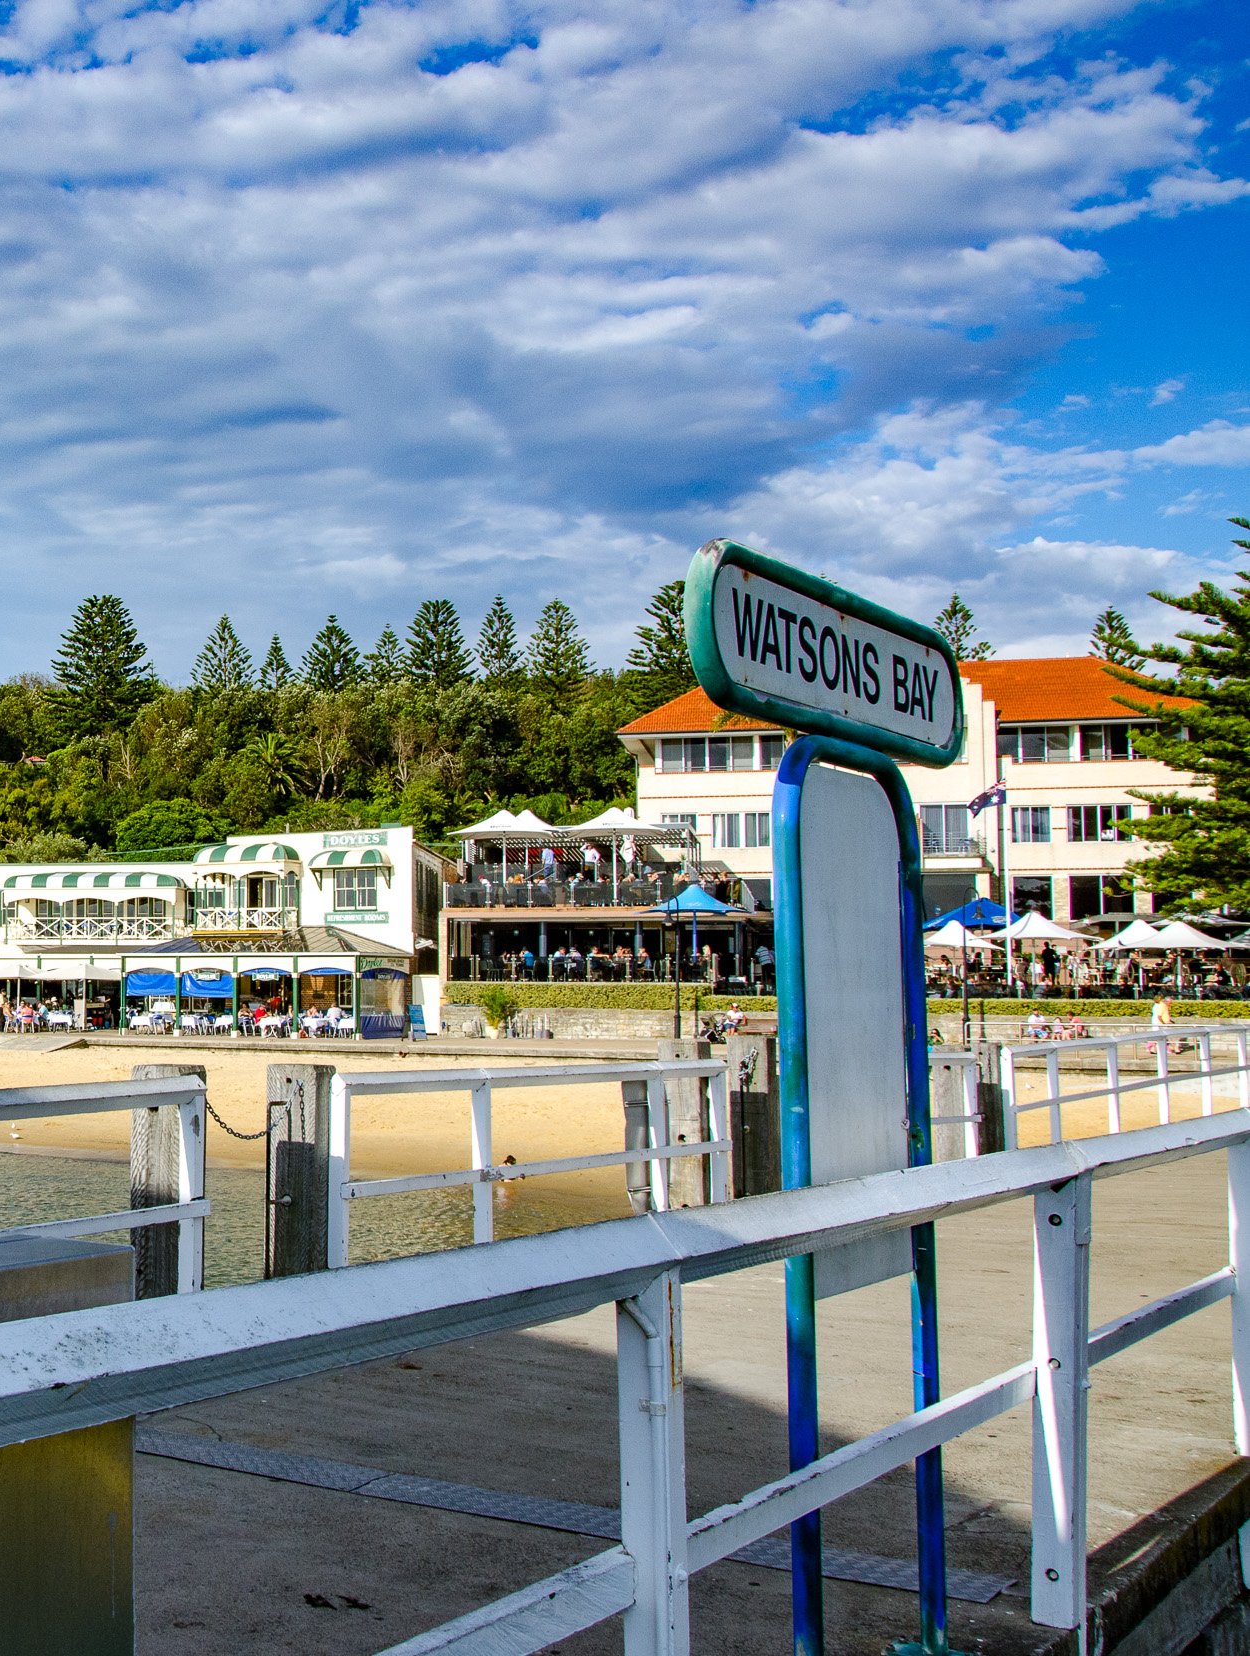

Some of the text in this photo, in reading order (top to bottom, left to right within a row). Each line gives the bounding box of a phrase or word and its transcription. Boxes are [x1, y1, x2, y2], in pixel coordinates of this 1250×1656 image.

[731, 587, 939, 722] WATSONS BAY
[330, 834, 380, 845] DOYLES
[327, 913, 386, 922] REFRESHMENT ROOMS
